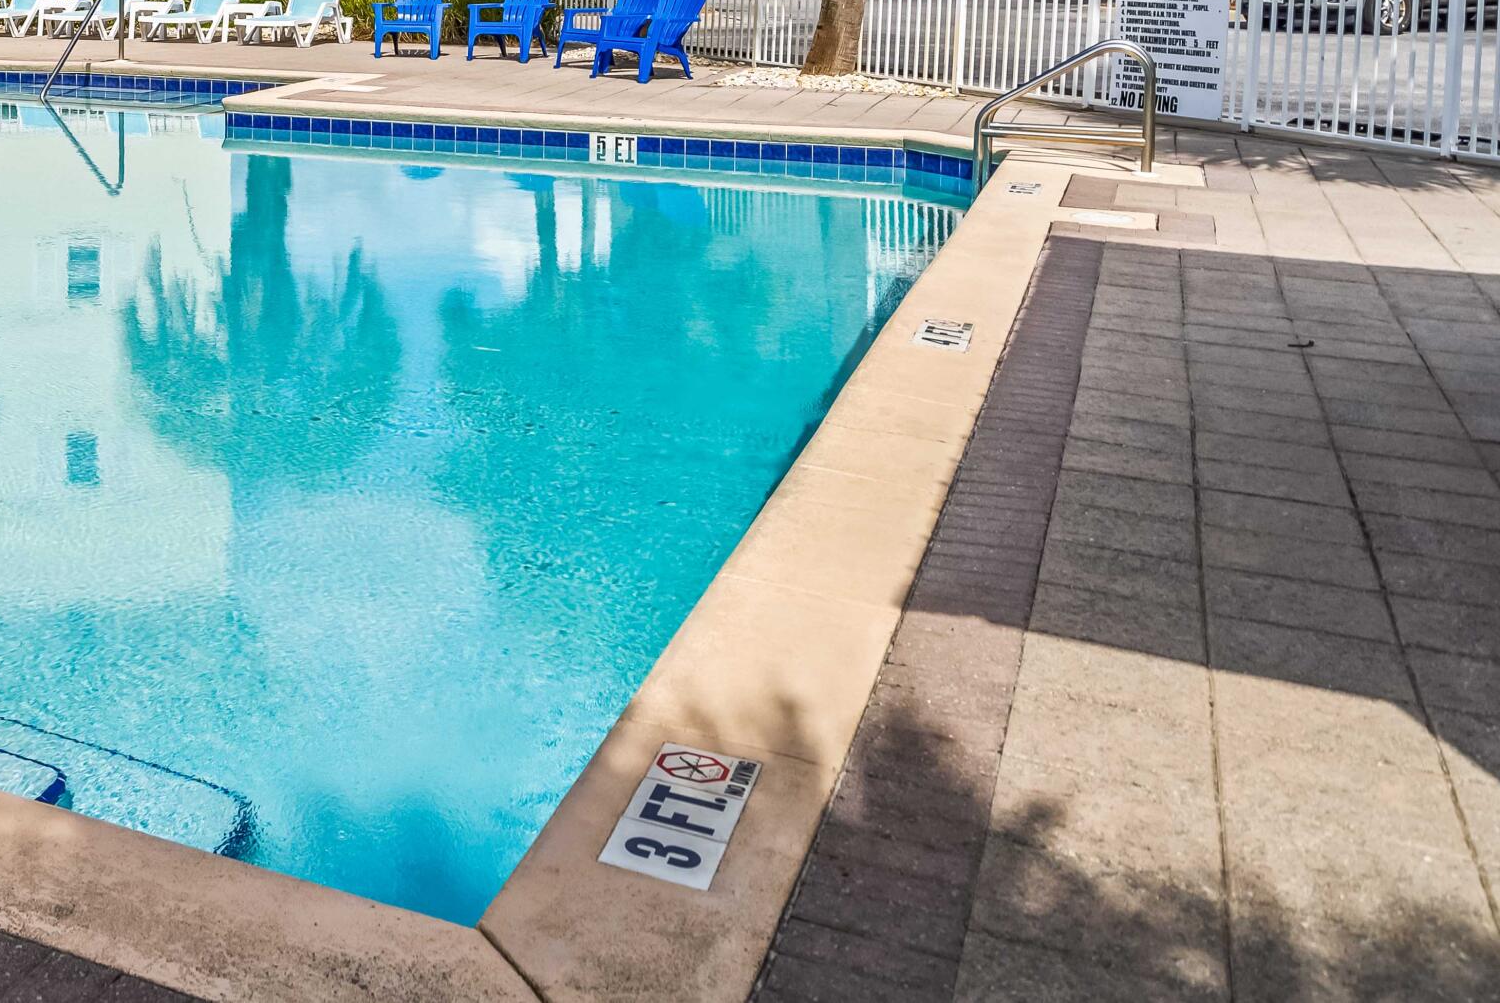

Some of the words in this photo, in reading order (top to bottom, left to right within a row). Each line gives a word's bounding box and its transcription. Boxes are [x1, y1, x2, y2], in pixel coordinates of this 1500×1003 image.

[1126, 34, 1138, 43] POOL
[1140, 36, 1167, 45] MAXIMUM
[1168, 37, 1187, 46] DEPTH:
[1194, 39, 1198, 48] 5
[1206, 40, 1219, 49] FEET
[1119, 91, 1136, 108] NO
[1138, 93, 1178, 113] DING
[639, 783, 728, 836] FT.
[624, 837, 702, 869] 3
